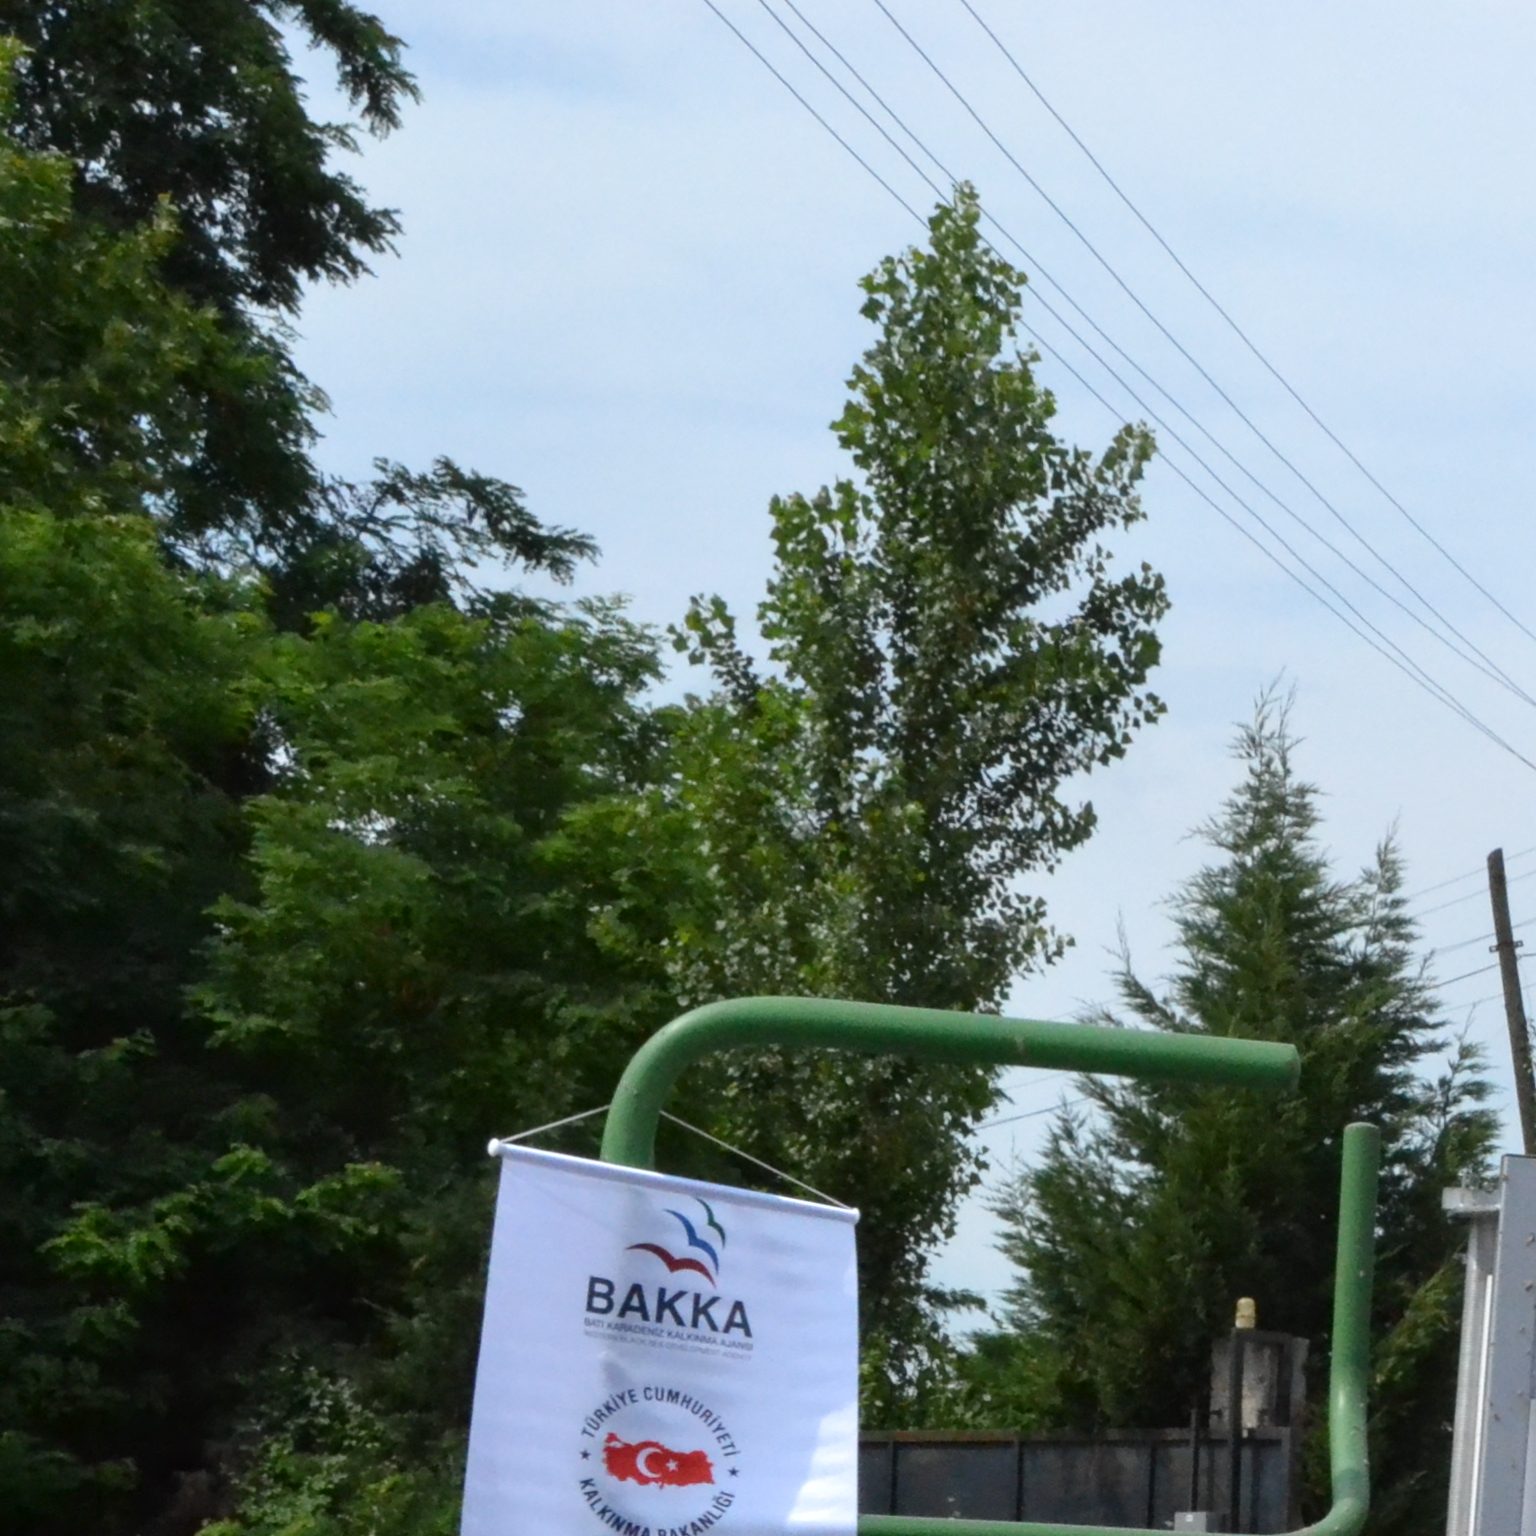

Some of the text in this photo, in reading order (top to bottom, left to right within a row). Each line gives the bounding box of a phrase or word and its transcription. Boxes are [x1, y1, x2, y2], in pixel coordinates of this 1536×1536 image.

[586, 1275, 753, 1338] BAKKA
[581, 1386, 741, 1457] TÜRKİYE CUMHURİYETİ
